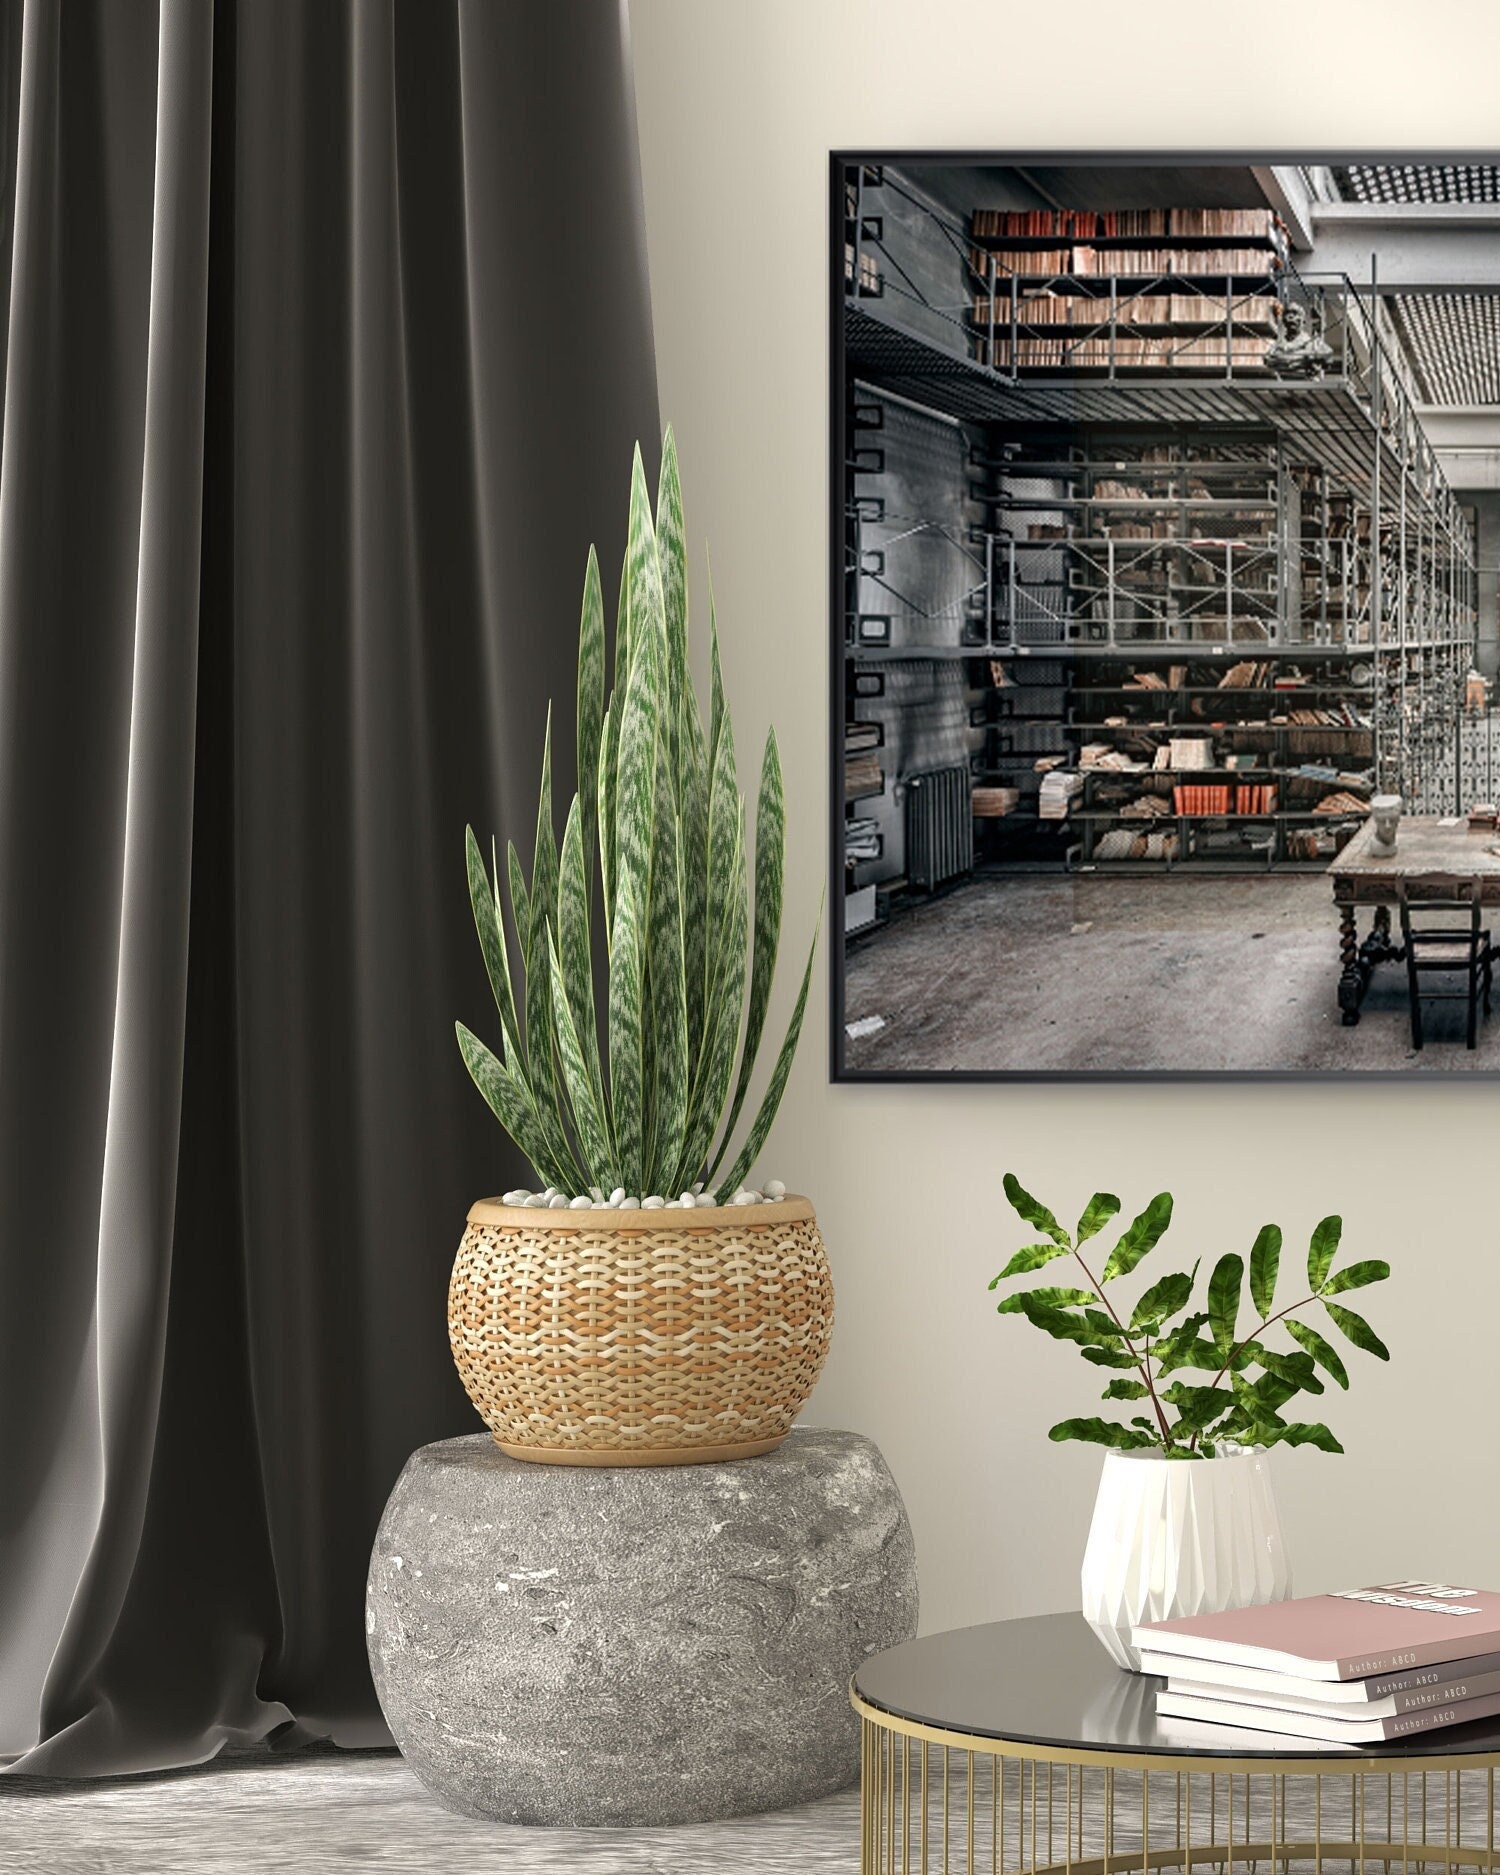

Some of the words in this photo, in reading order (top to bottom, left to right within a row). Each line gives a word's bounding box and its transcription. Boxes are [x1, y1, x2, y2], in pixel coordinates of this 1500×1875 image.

[1377, 1579, 1478, 1599] The
[1327, 1589, 1483, 1616] Wisdom
[1349, 1660, 1387, 1673] Author:
[1392, 1653, 1416, 1665] ABCD
[1376, 1680, 1412, 1694] Author:
[1416, 1673, 1439, 1685] ABCD
[1405, 1693, 1440, 1707] Author:
[1444, 1686, 1467, 1699] ABCD
[1394, 1718, 1429, 1732] Author:
[1433, 1710, 1455, 1723] ABCD
